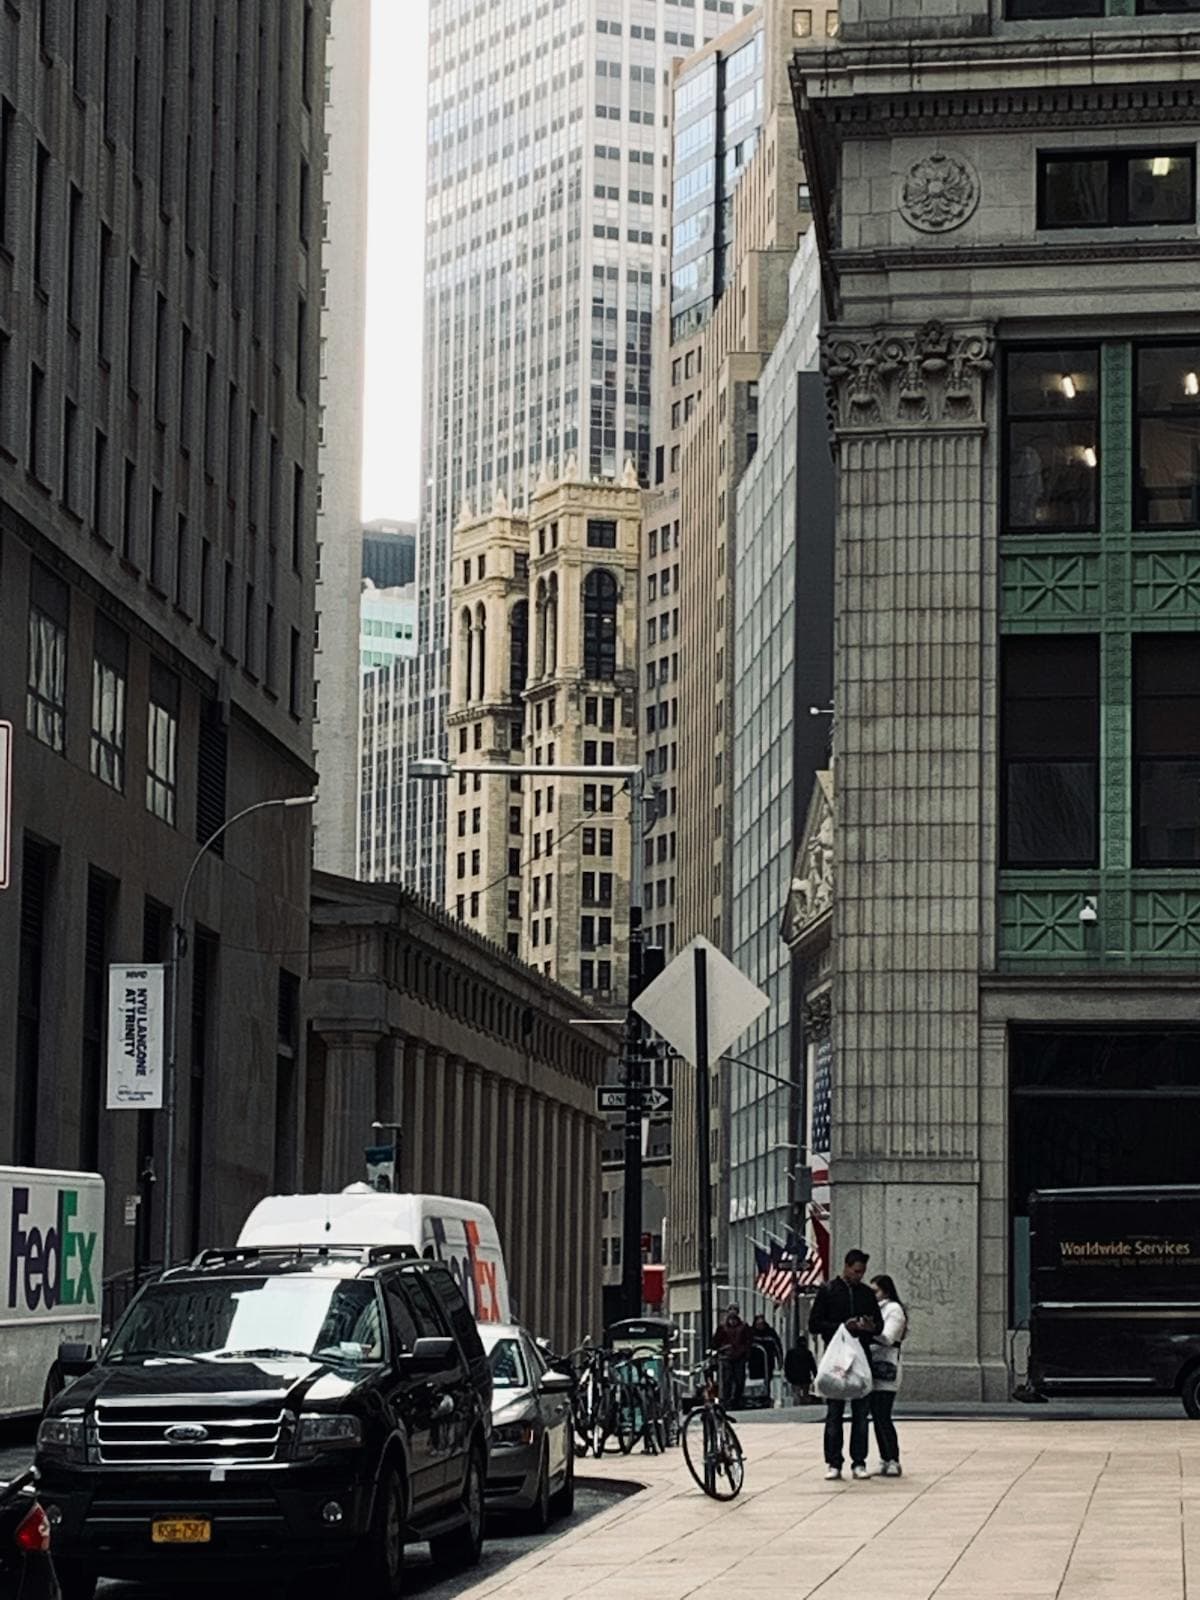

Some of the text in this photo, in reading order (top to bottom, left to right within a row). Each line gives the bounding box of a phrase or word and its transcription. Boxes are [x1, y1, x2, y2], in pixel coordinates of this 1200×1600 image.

[125, 988, 136, 1058] AT TRINITY
[137, 988, 147, 1015] NYU
[8, 1187, 97, 1311] FedEx
[1060, 1240, 1190, 1255] Worldwide Services
